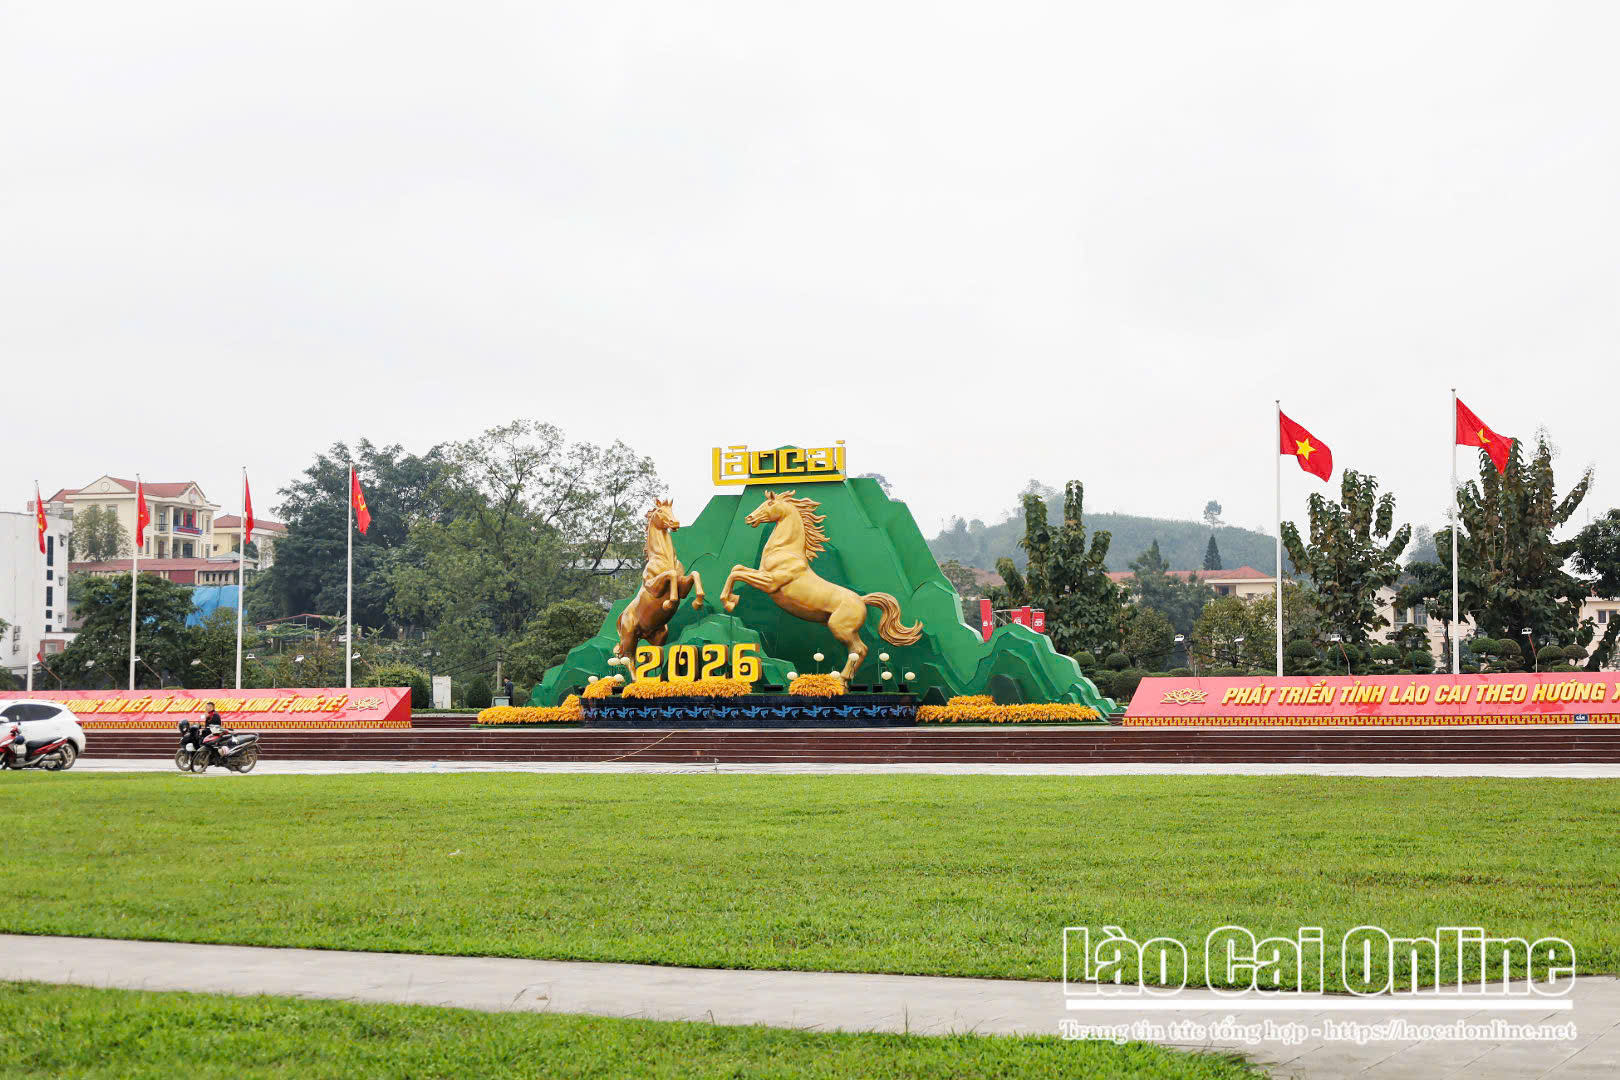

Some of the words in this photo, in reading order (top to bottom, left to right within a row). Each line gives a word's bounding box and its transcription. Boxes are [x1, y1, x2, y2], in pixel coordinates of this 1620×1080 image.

[635, 643, 762, 683] 2026
[1221, 683, 1275, 706] PHÁT
[1277, 679, 1336, 705] TRIỂN
[1339, 680, 1387, 704] TỈNH
[1388, 682, 1430, 704] LÀO
[1434, 684, 1471, 704] CAI
[1475, 683, 1528, 704] THEO
[1531, 679, 1607, 704] HƯỚNG
